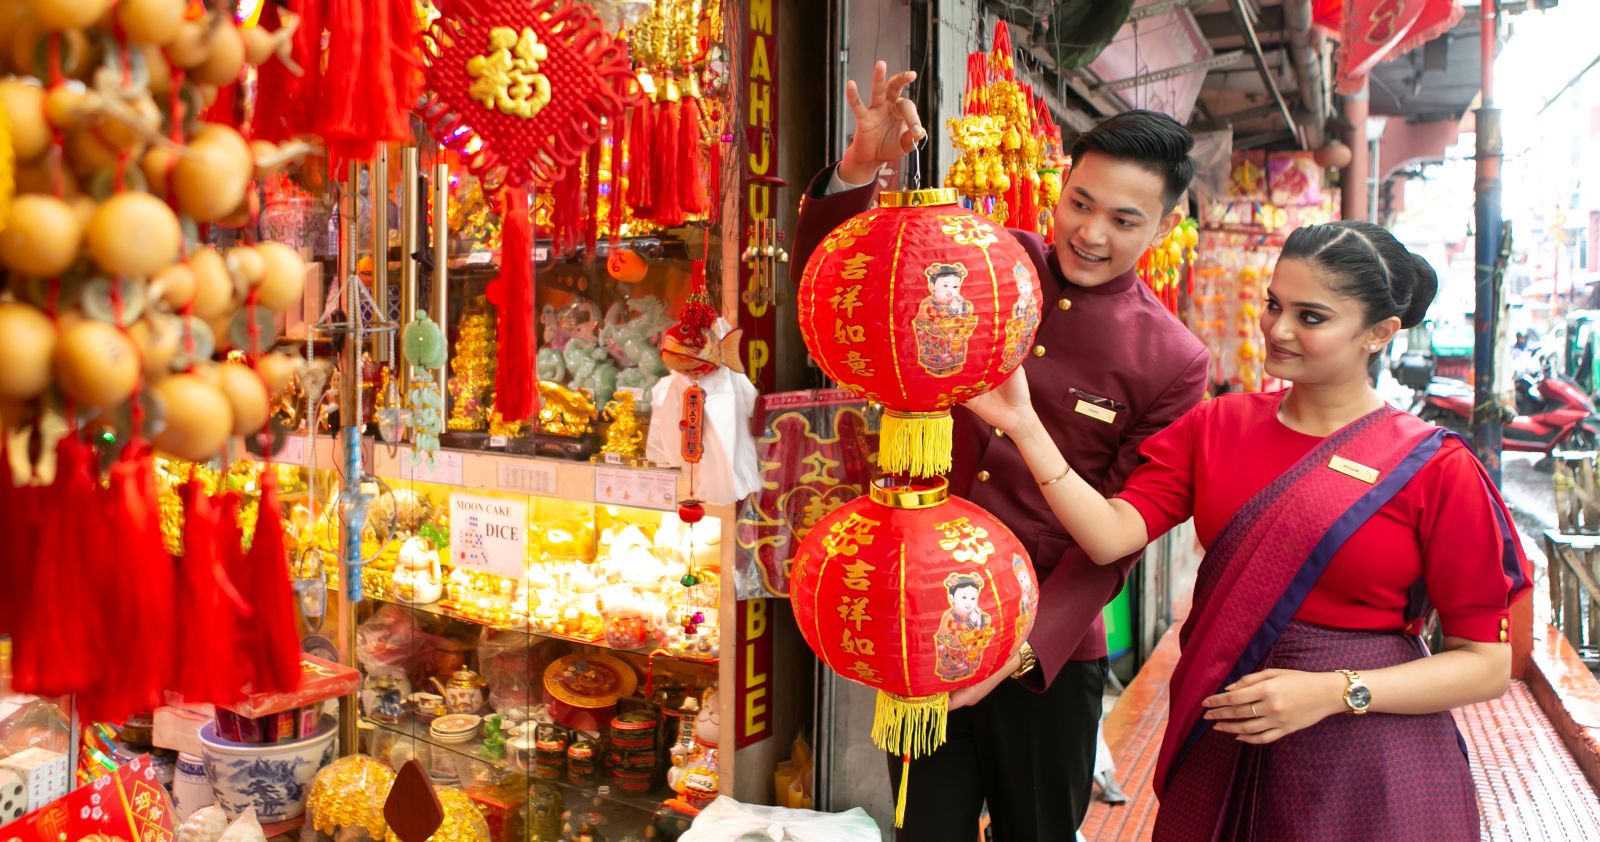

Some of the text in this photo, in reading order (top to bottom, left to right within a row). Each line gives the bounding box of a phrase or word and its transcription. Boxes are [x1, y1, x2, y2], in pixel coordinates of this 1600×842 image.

[465, 26, 551, 119] 福
[829, 252, 875, 377] 吉祥如意
[456, 500, 512, 517] MOON CAKE
[485, 522, 519, 541] DICE
[837, 559, 883, 683] 吉祥如意
